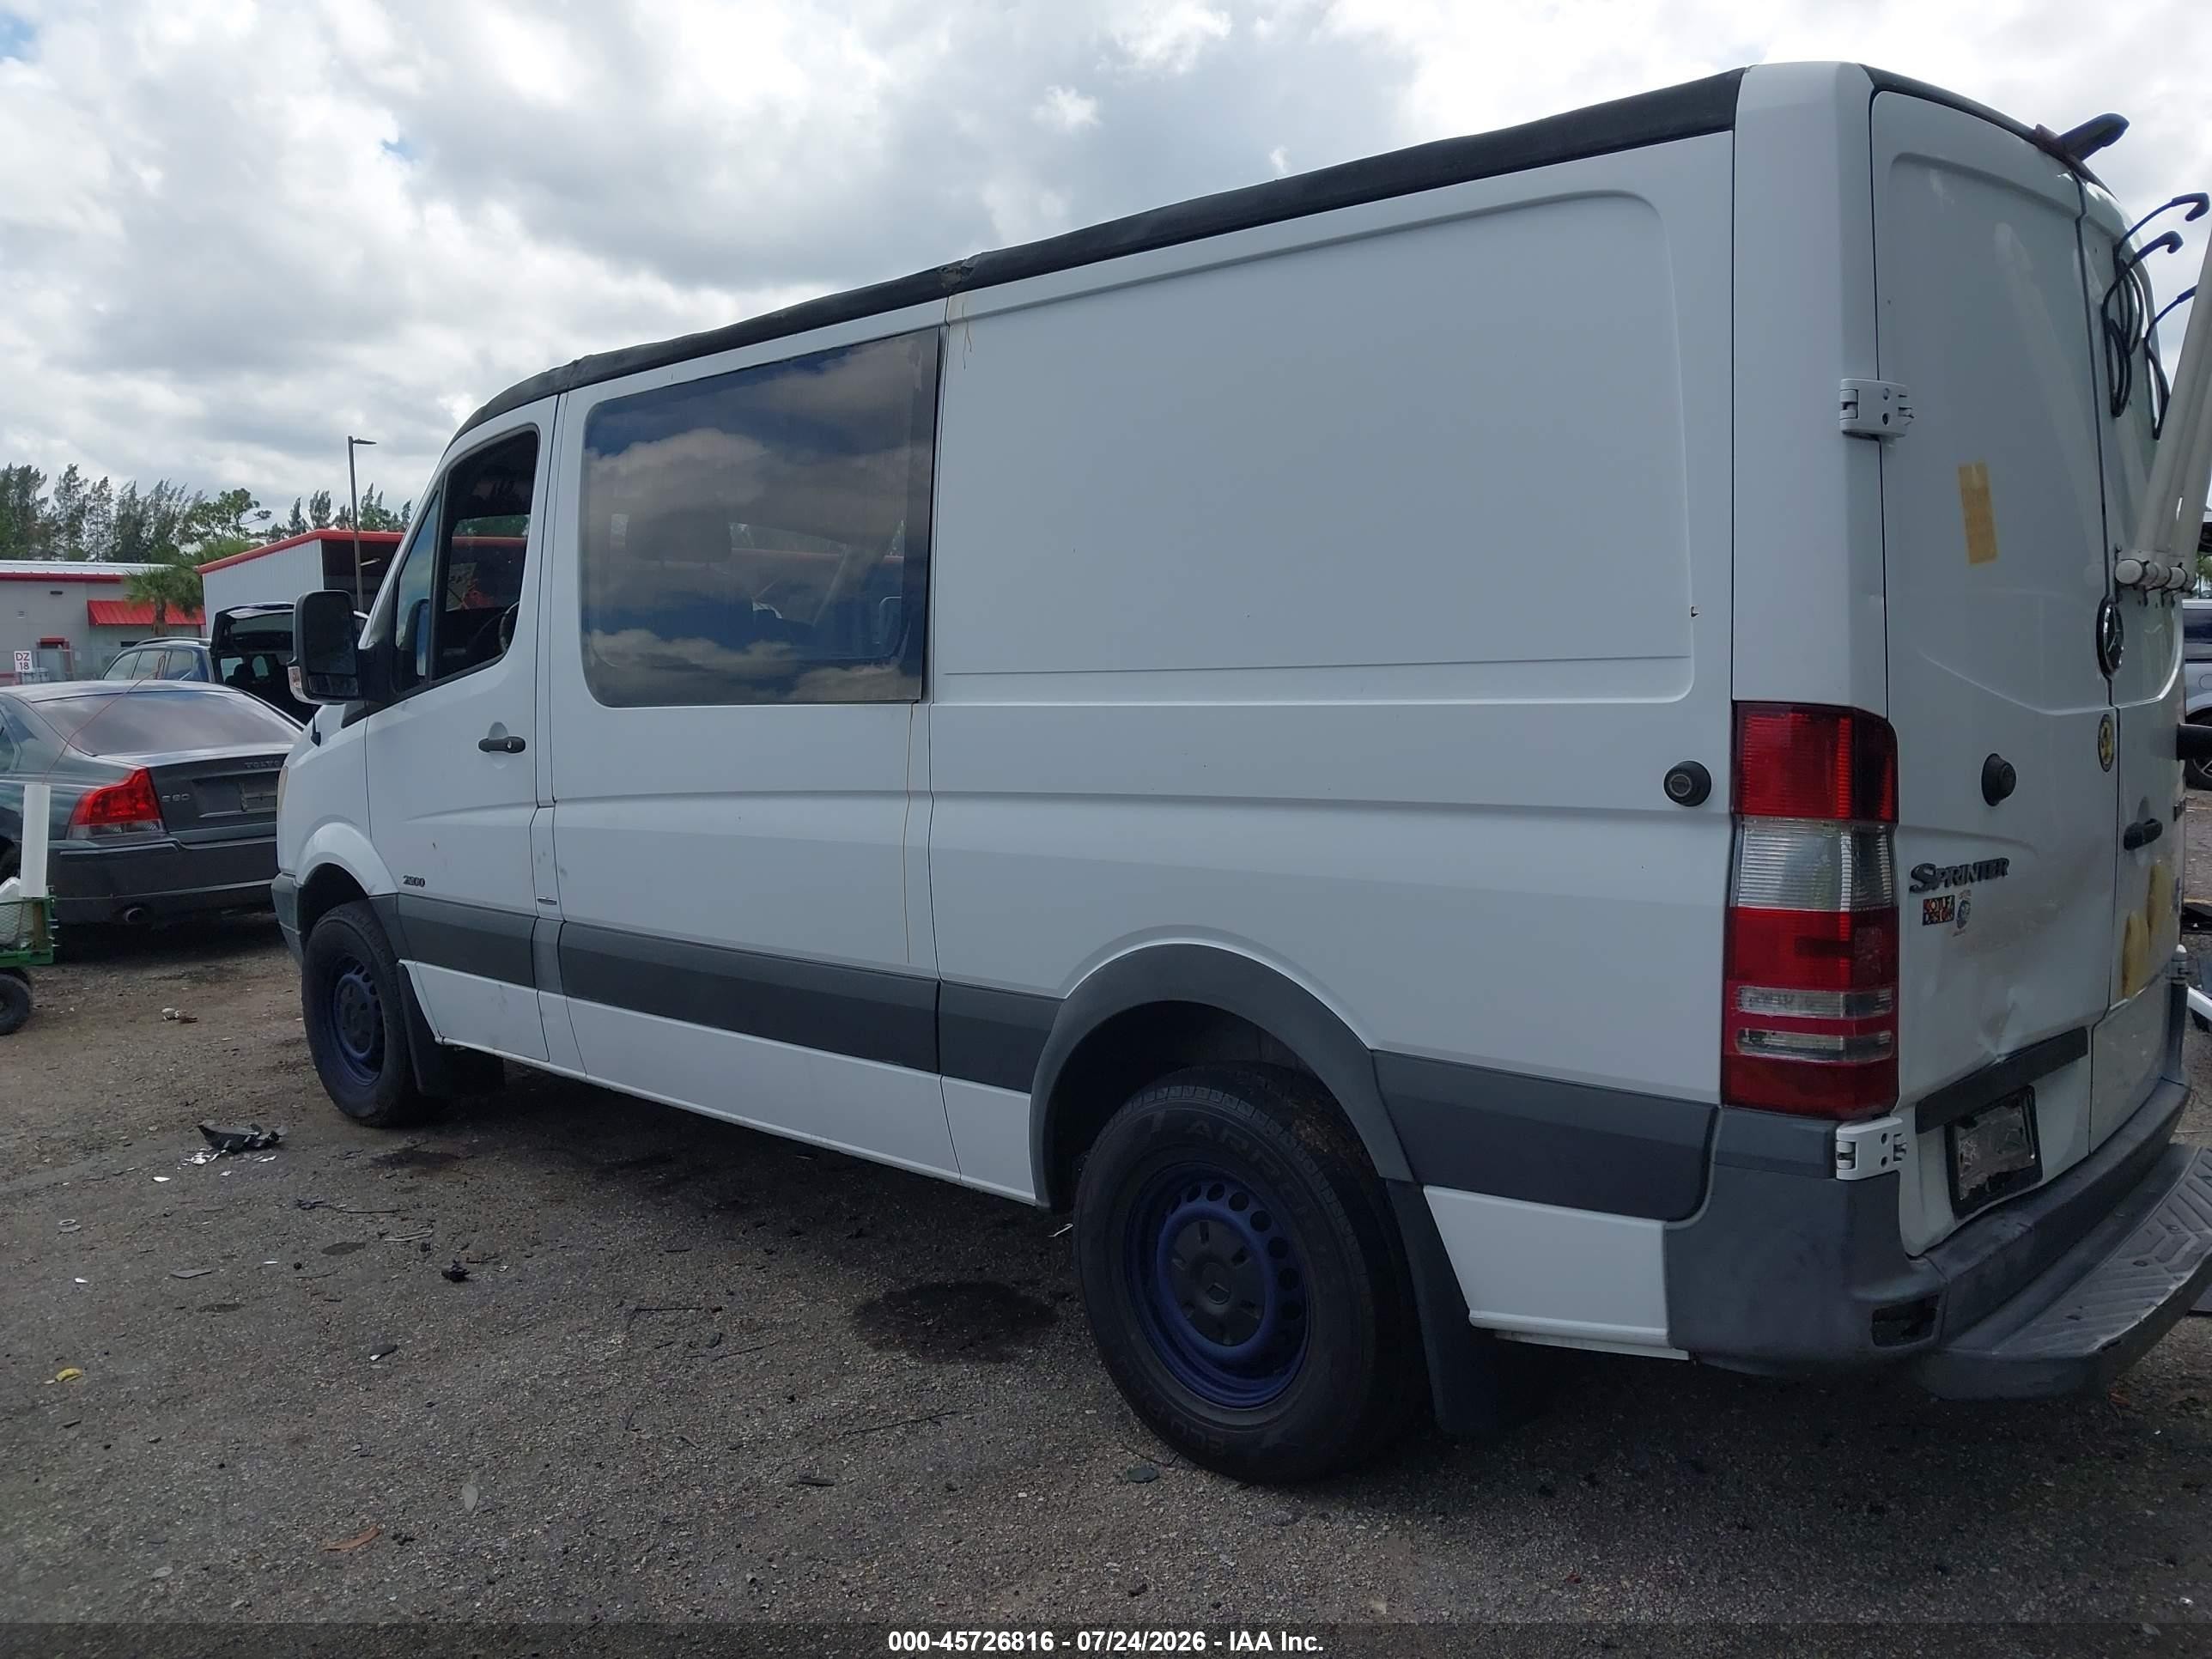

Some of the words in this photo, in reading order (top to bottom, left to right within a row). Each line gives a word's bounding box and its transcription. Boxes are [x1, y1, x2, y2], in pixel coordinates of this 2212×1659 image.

[15, 653, 30, 661] DZ
[19, 661, 30, 671] 18
[1909, 857, 2010, 894] SPRINTER
